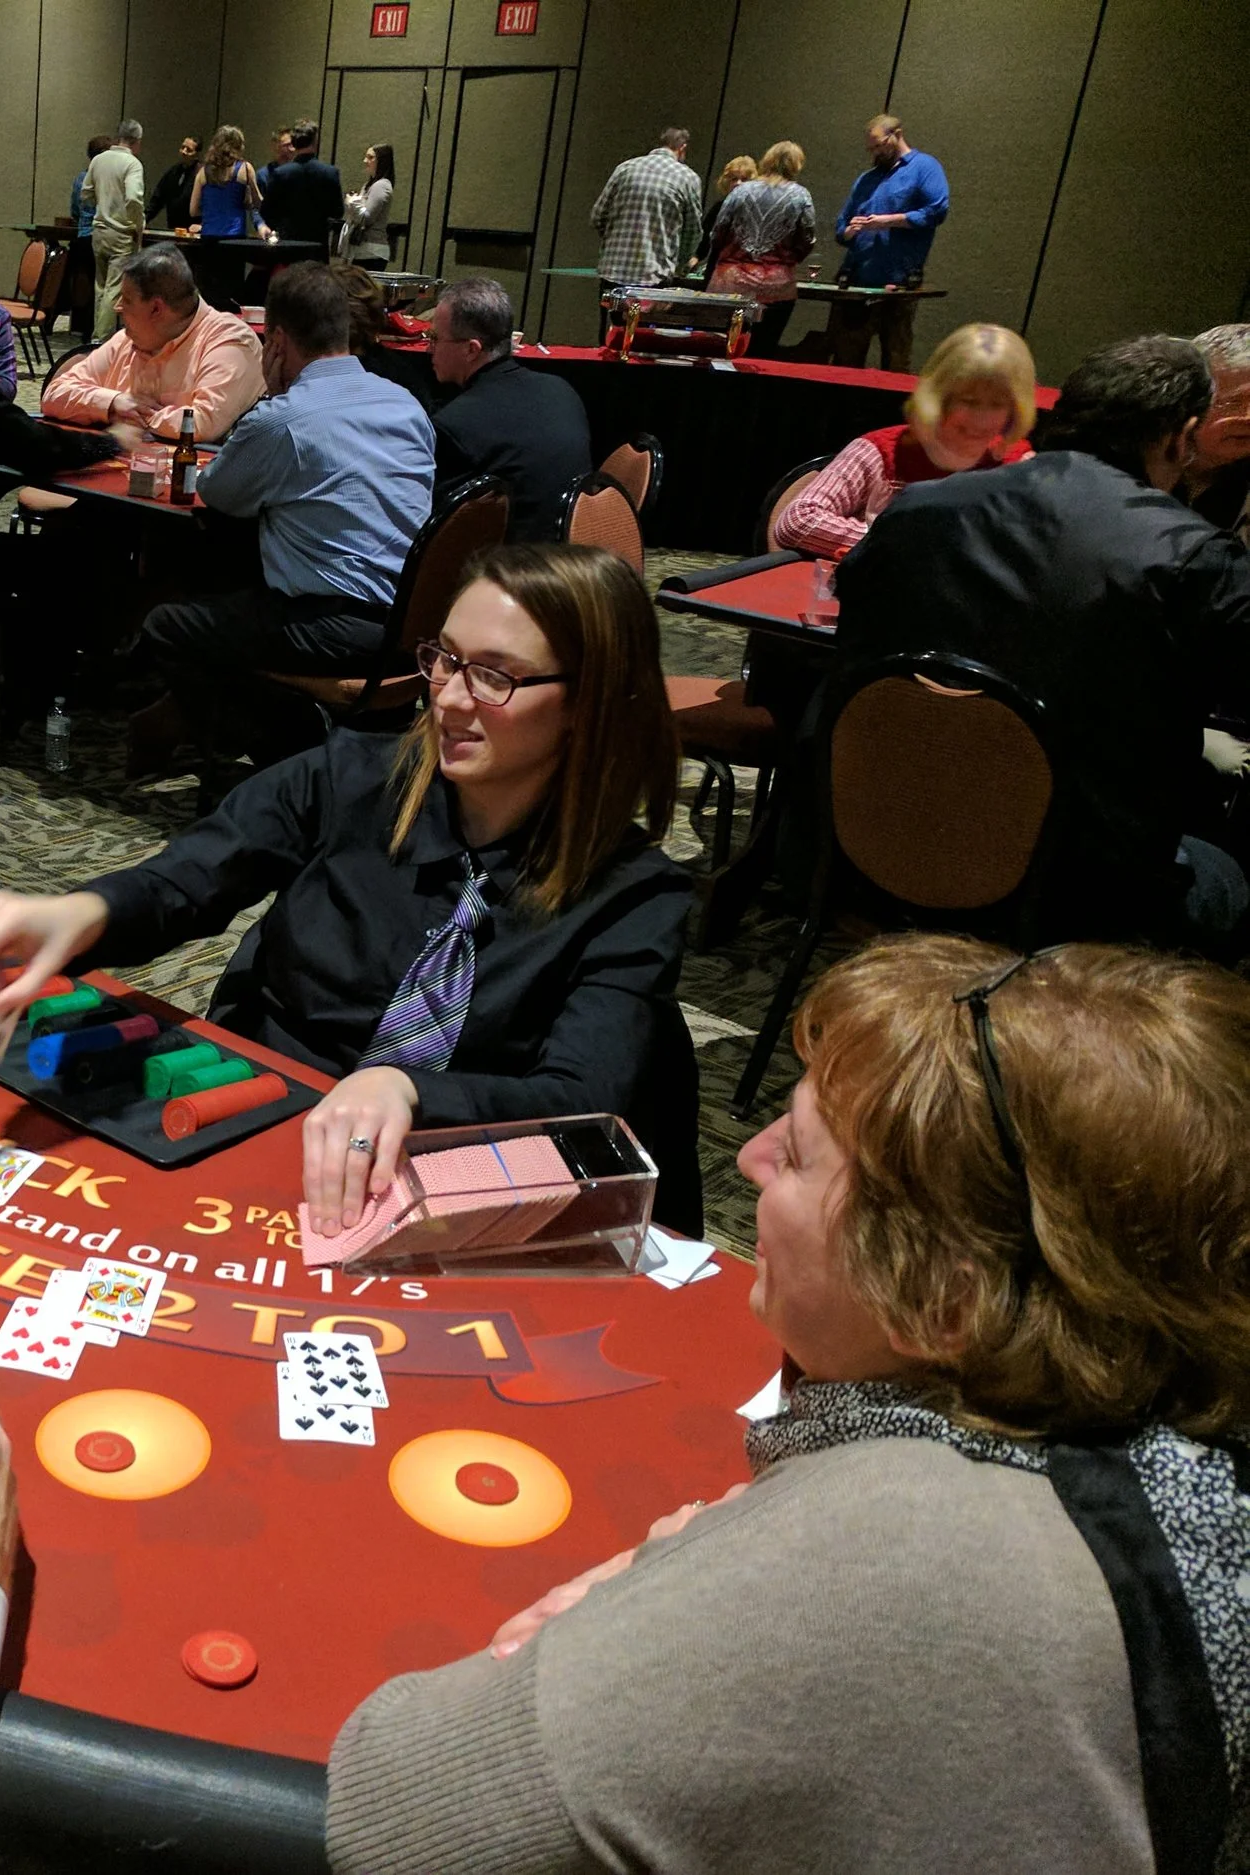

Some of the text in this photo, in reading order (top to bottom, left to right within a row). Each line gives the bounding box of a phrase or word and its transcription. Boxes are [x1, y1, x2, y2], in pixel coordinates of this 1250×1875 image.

[377, 9, 404, 33] EXIT
[504, 6, 533, 31] EXIT
[182, 1195, 233, 1235] 3
[245, 1205, 300, 1230] PA
[127, 1244, 199, 1274] on
[214, 1256, 287, 1288] all
[152, 1289, 197, 1333] 2
[232, 1302, 407, 1356] TO
[446, 1319, 509, 1360] 1
